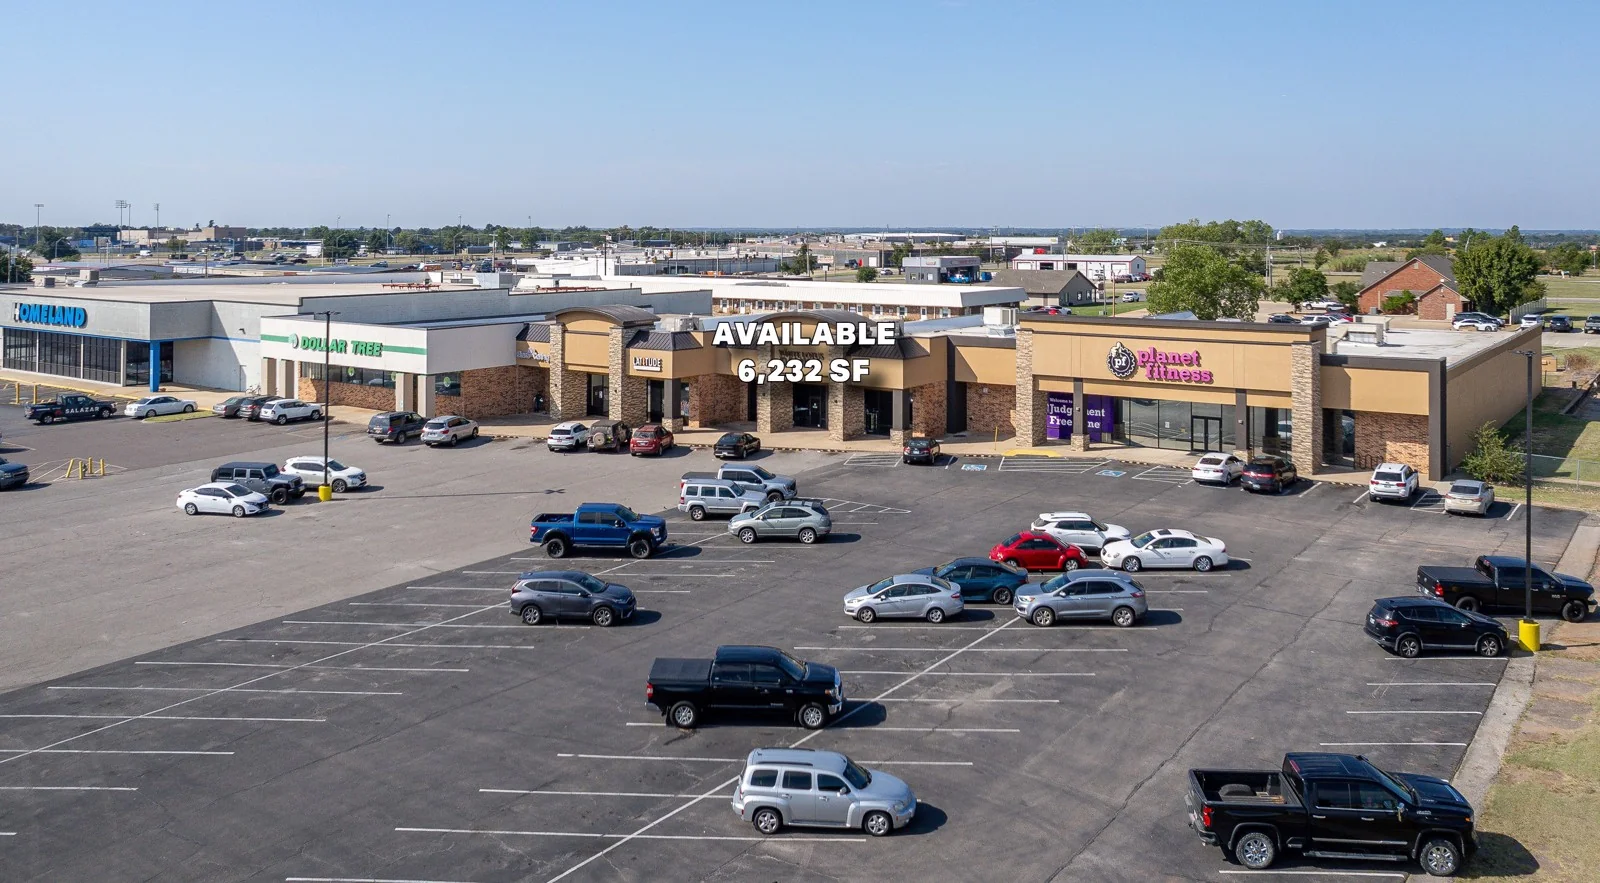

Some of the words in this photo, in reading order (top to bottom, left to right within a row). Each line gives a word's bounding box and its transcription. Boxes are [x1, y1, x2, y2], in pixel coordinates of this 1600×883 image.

[13, 303, 87, 328] HOMELAND
[300, 336, 347, 354] DOLLAR
[351, 341, 383, 357] TREE
[633, 357, 662, 367] LATITUDE
[1114, 357, 1127, 369] pf
[1137, 347, 1201, 367] planet
[1145, 362, 1213, 384] fitness
[65, 406, 100, 414] SALAZAR
[1049, 415, 1073, 426] Free
